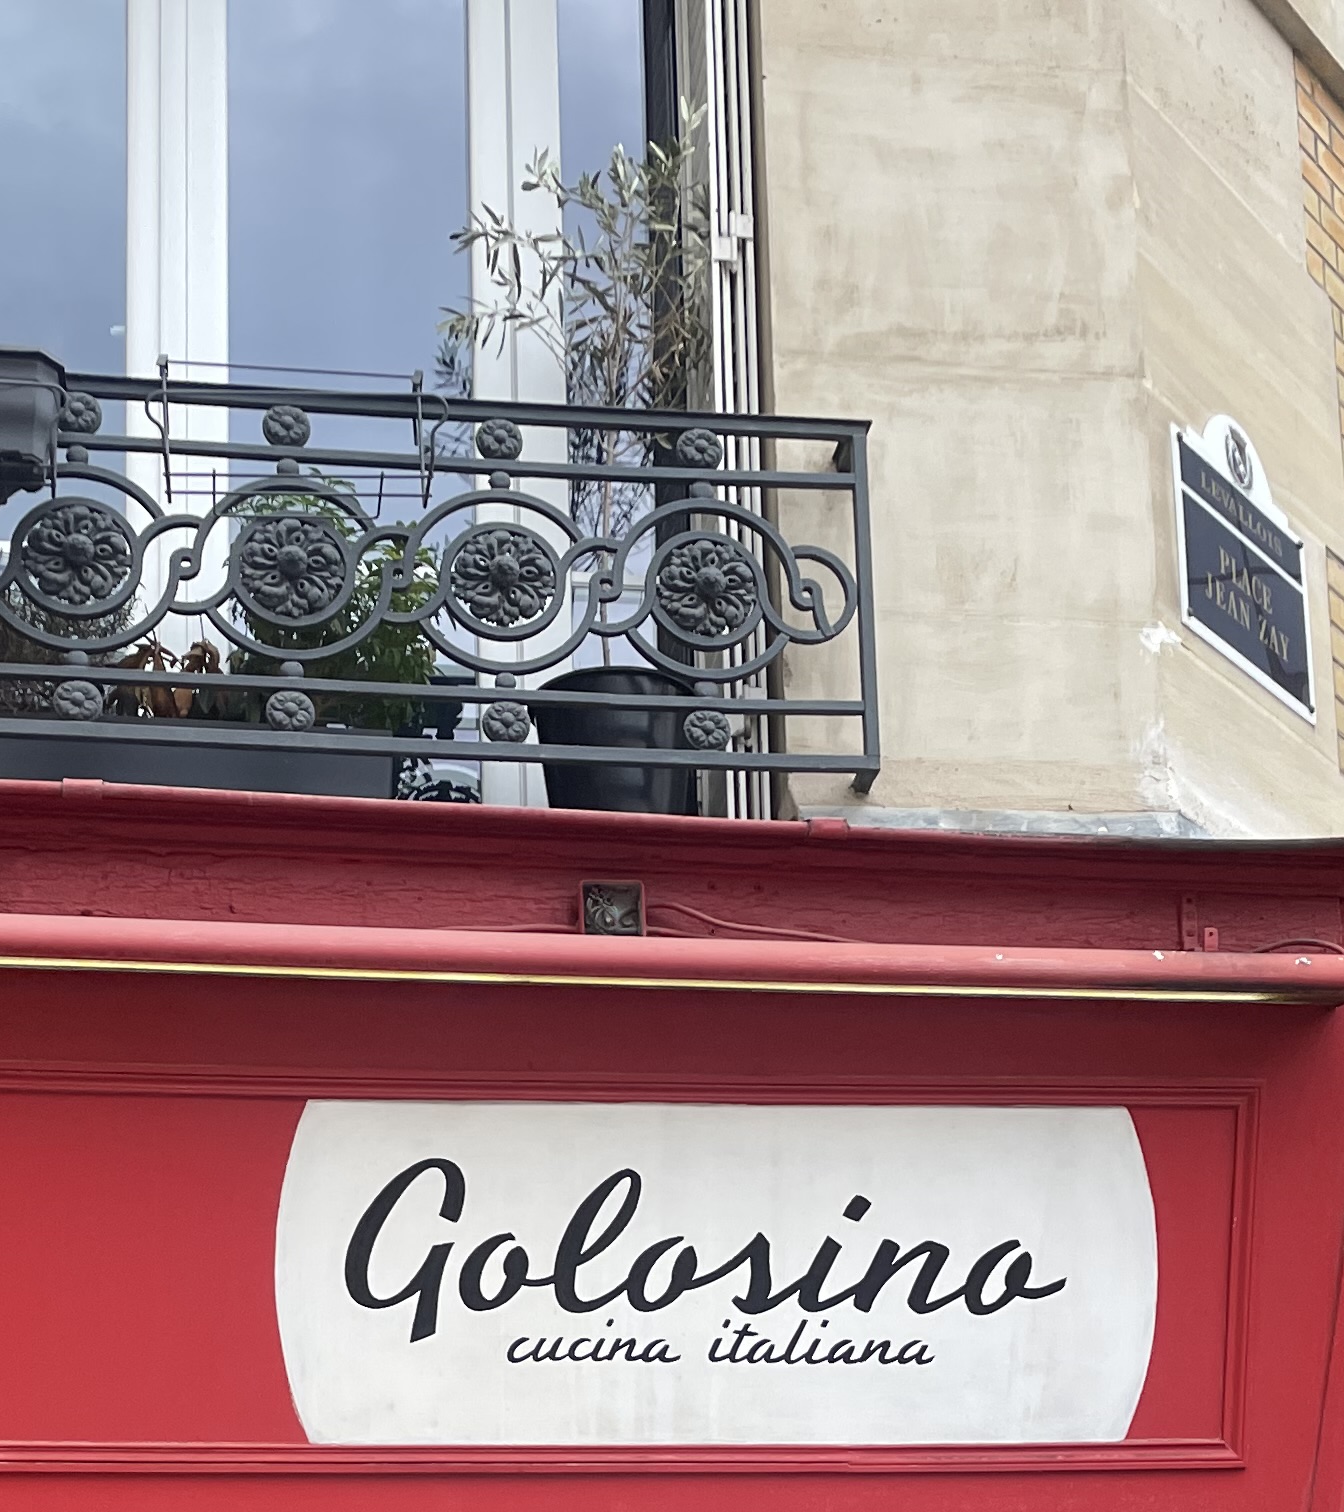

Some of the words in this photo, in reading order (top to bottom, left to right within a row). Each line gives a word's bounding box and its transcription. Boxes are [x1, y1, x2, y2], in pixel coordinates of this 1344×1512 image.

[1200, 470, 1283, 557] LEVALLOIS
[1204, 572, 1252, 632] JEAN
[1258, 614, 1290, 663] ZAY
[1218, 545, 1274, 616] PLACE
[343, 1157, 1068, 1343] Golosino
[505, 1318, 682, 1365] cucina
[707, 1318, 936, 1366] italiana
